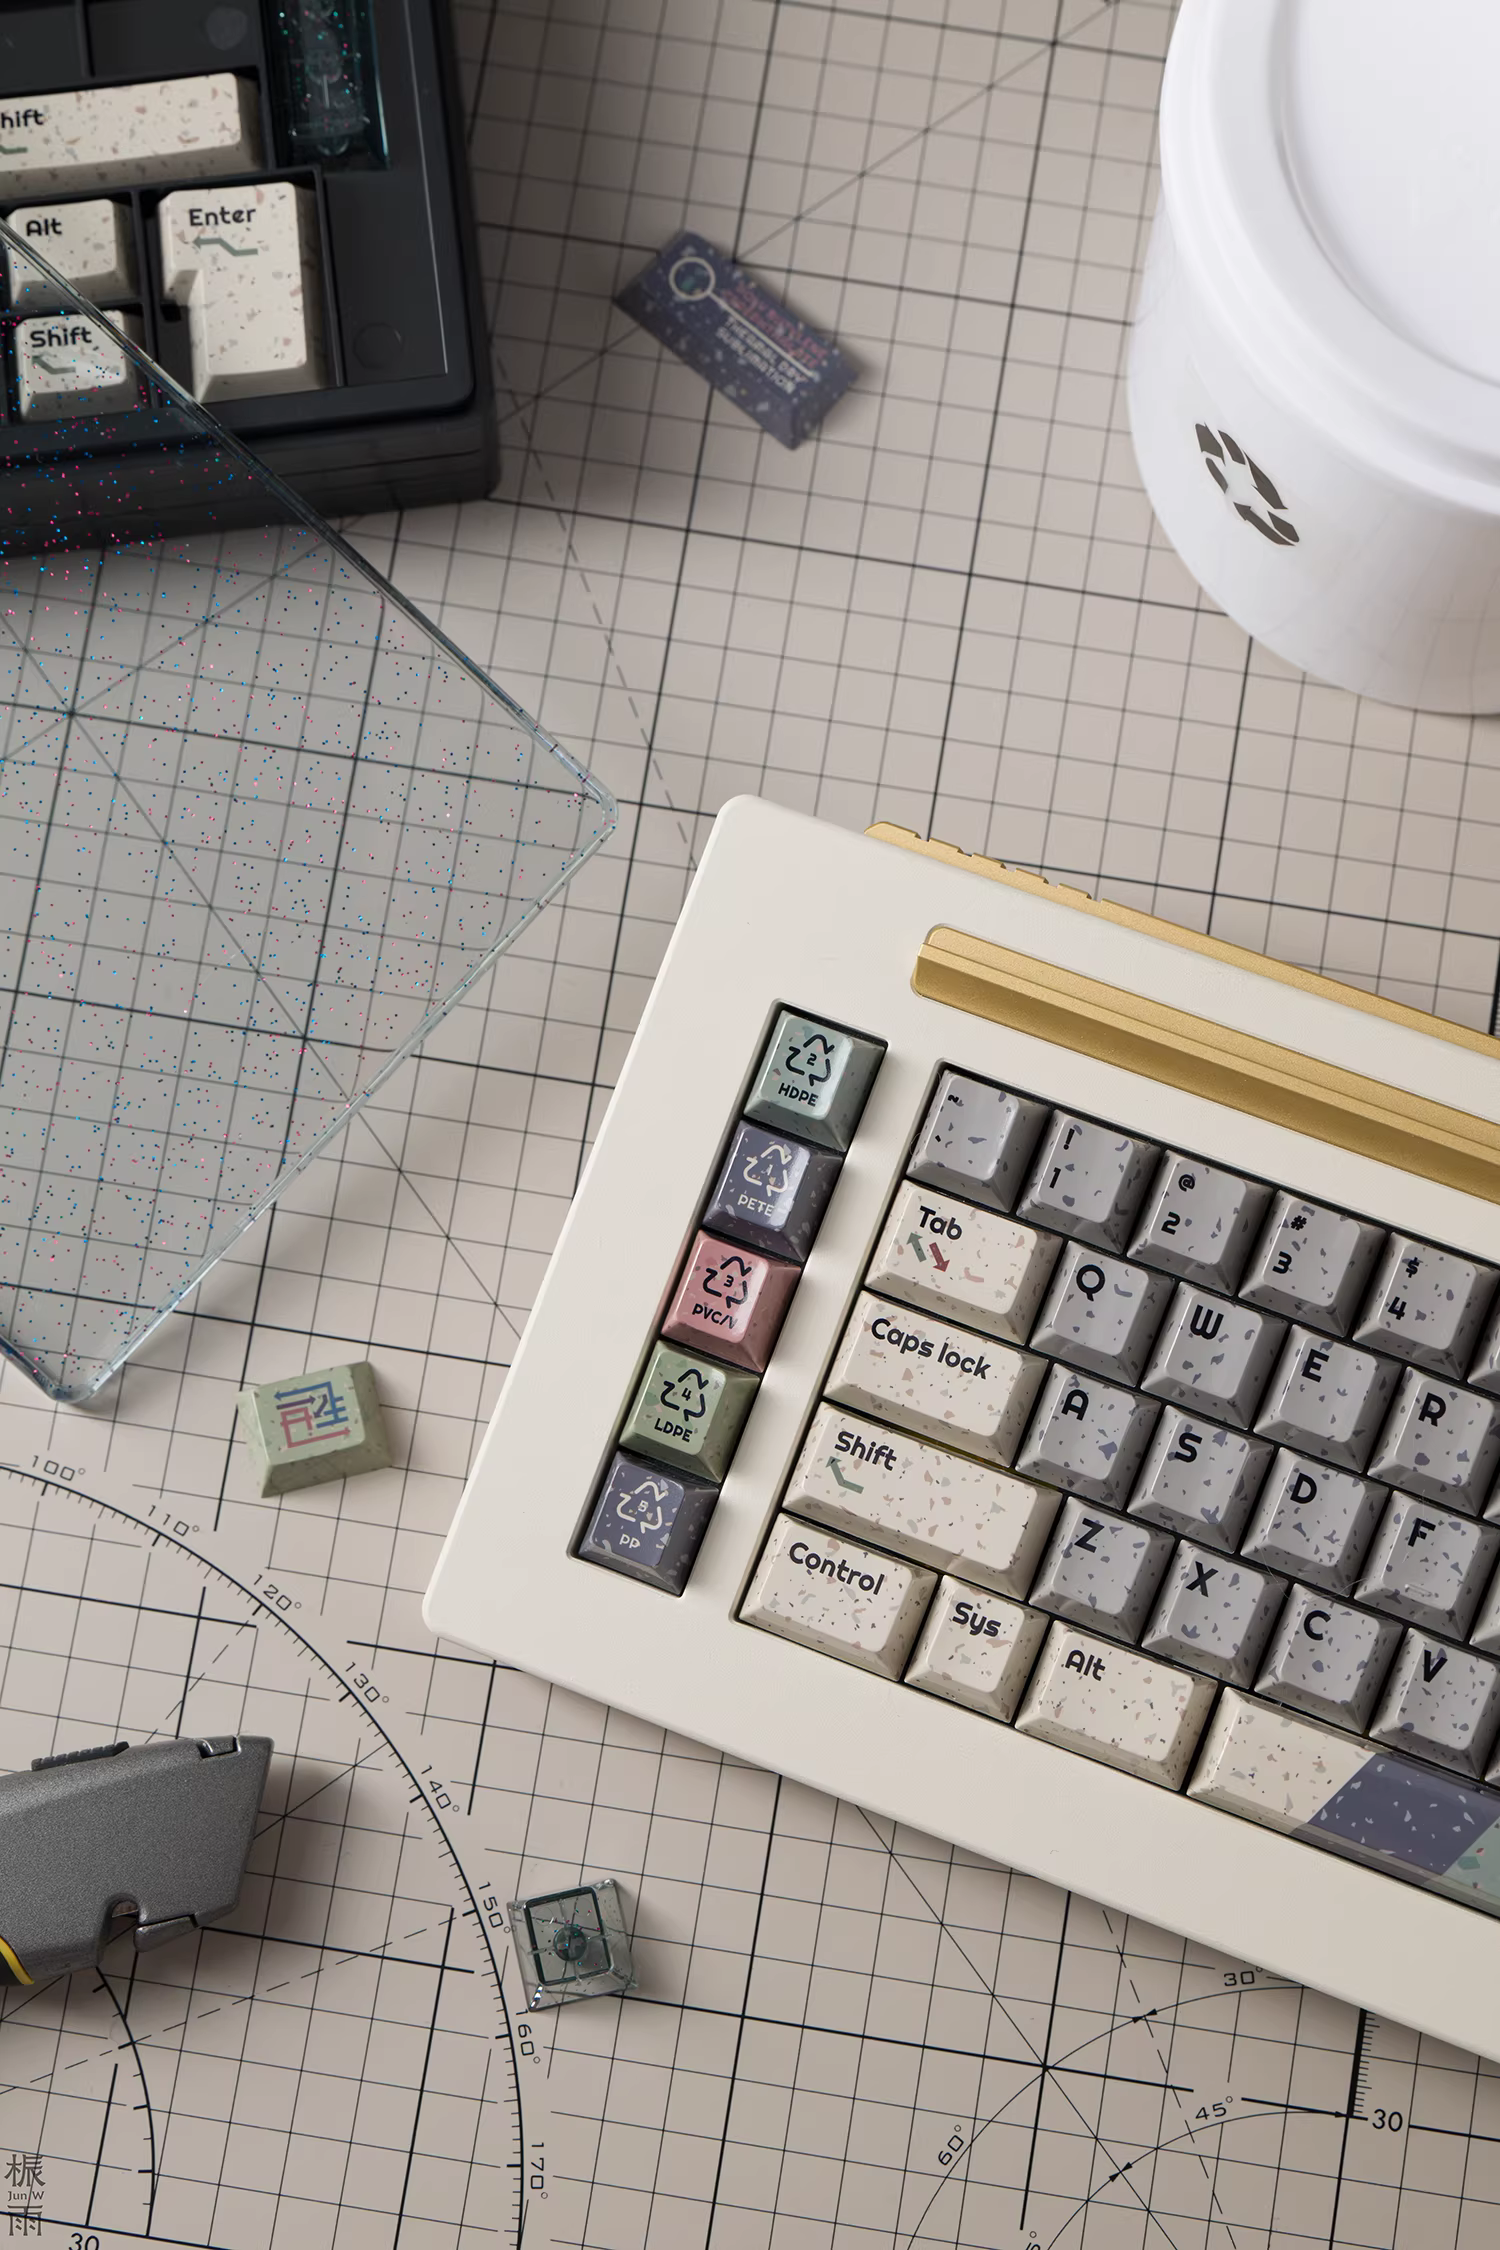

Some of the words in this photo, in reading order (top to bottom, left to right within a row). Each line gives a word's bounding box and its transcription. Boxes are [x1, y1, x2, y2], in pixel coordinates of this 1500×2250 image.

[0, 109, 44, 129] hift
[26, 218, 62, 237] Alt
[188, 206, 256, 227] Enter
[30, 326, 92, 348] Shift
[806, 1053, 817, 1067] 2
[778, 1082, 818, 1107] HDPE
[1063, 1128, 1075, 1150] !
[1049, 1167, 1061, 1189] 1
[1178, 1173, 1195, 1192] @
[737, 1193, 775, 1217] PETE
[919, 1205, 962, 1241] Tab
[1160, 1211, 1181, 1235] 2
[1290, 1215, 1307, 1231] #
[1272, 1250, 1293, 1275] 3
[1405, 1256, 1420, 1278] $
[723, 1274, 735, 1288] 3
[1075, 1263, 1106, 1302] Q
[1387, 1296, 1407, 1320] 4
[1189, 1304, 1224, 1340] W
[871, 1317, 935, 1358] Caps
[937, 1341, 991, 1380] lock
[1301, 1348, 1330, 1383] E
[681, 1387, 692, 1402] 4
[1061, 1388, 1090, 1421] A
[1418, 1391, 1447, 1427] R
[654, 1417, 693, 1442] LDPE
[834, 1430, 897, 1472] Shift
[1174, 1431, 1203, 1463] S
[1290, 1472, 1318, 1504] D
[619, 1533, 641, 1549] PP
[1074, 1517, 1105, 1554] Z
[1407, 1517, 1436, 1547] F
[789, 1541, 885, 1596] Control
[1185, 1561, 1219, 1598] X
[952, 1601, 1002, 1637] Sys
[1303, 1610, 1332, 1641] C
[1064, 1649, 1106, 1682] Alt
[1423, 1649, 1448, 1683] V
[1371, 2108, 1404, 2132] 30
[68, 2232, 100, 2250] 30
